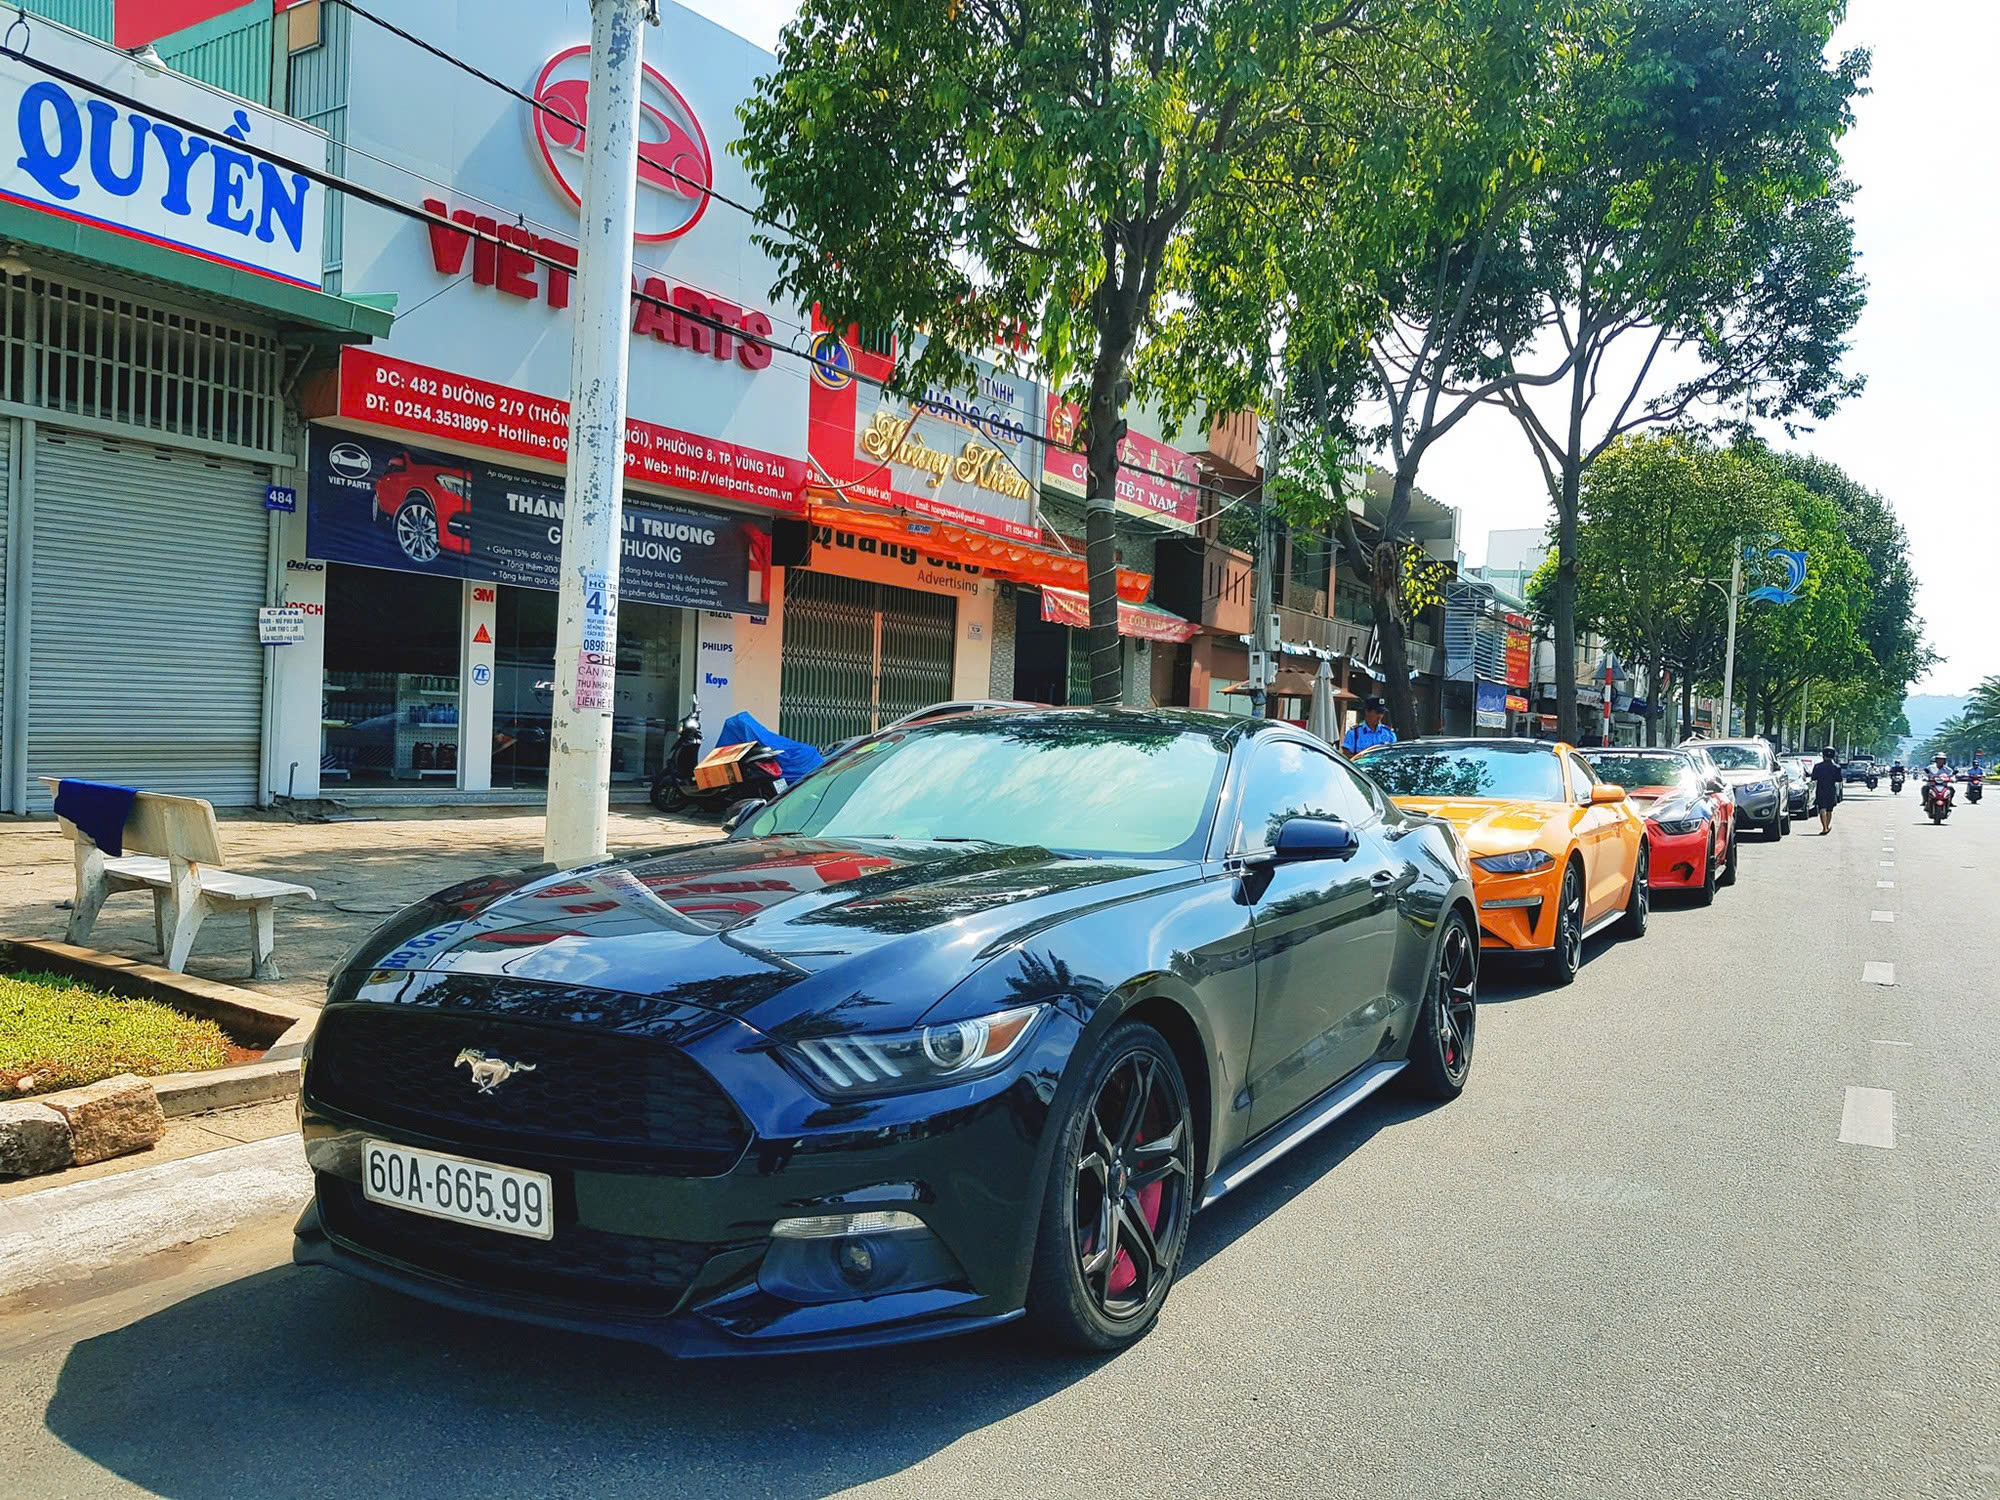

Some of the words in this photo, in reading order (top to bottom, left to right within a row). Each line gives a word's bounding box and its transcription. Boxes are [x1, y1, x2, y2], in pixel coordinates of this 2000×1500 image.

[17, 81, 310, 253] QUYỀN
[424, 198, 578, 309] VIET
[631, 272, 773, 370] ARTS
[984, 377, 1014, 404] TNHH
[375, 367, 405, 389] ĐC:
[409, 376, 438, 397] 482
[442, 383, 496, 410] ĐƯỜNG
[499, 398, 525, 417] 2/9
[528, 402, 570, 427] (THỐN
[656, 436, 703, 459] PHƯỜNG
[719, 451, 733, 467] TP.
[735, 454, 764, 474] VŨNG
[766, 459, 786, 478] TÀU
[365, 393, 390, 412] ĐT:
[394, 399, 489, 434] 0254.3531899
[498, 423, 551, 448] Hotline:
[552, 436, 570, 452] 09
[622, 453, 636, 467] 99
[644, 457, 672, 475] Web:
[675, 466, 793, 502] http://vietparts.com.vn
[328, 476, 346, 486] VIET
[347, 479, 371, 490] PARTS
[269, 490, 293, 504] 484
[1148, 491, 1179, 515] NAM
[506, 492, 565, 520] THÁN
[620, 513, 635, 532] AI
[514, 548, 529, 558] 15%
[544, 564, 559, 574] 200
[473, 587, 495, 603] 3M
[917, 569, 979, 596] Advertising
[586, 591, 617, 618] 4.2
[702, 641, 724, 653] PHILIPS
[475, 668, 490, 681] ZF
[705, 672, 728, 688] Koyo
[370, 1150, 543, 1228] 60A-665.99
